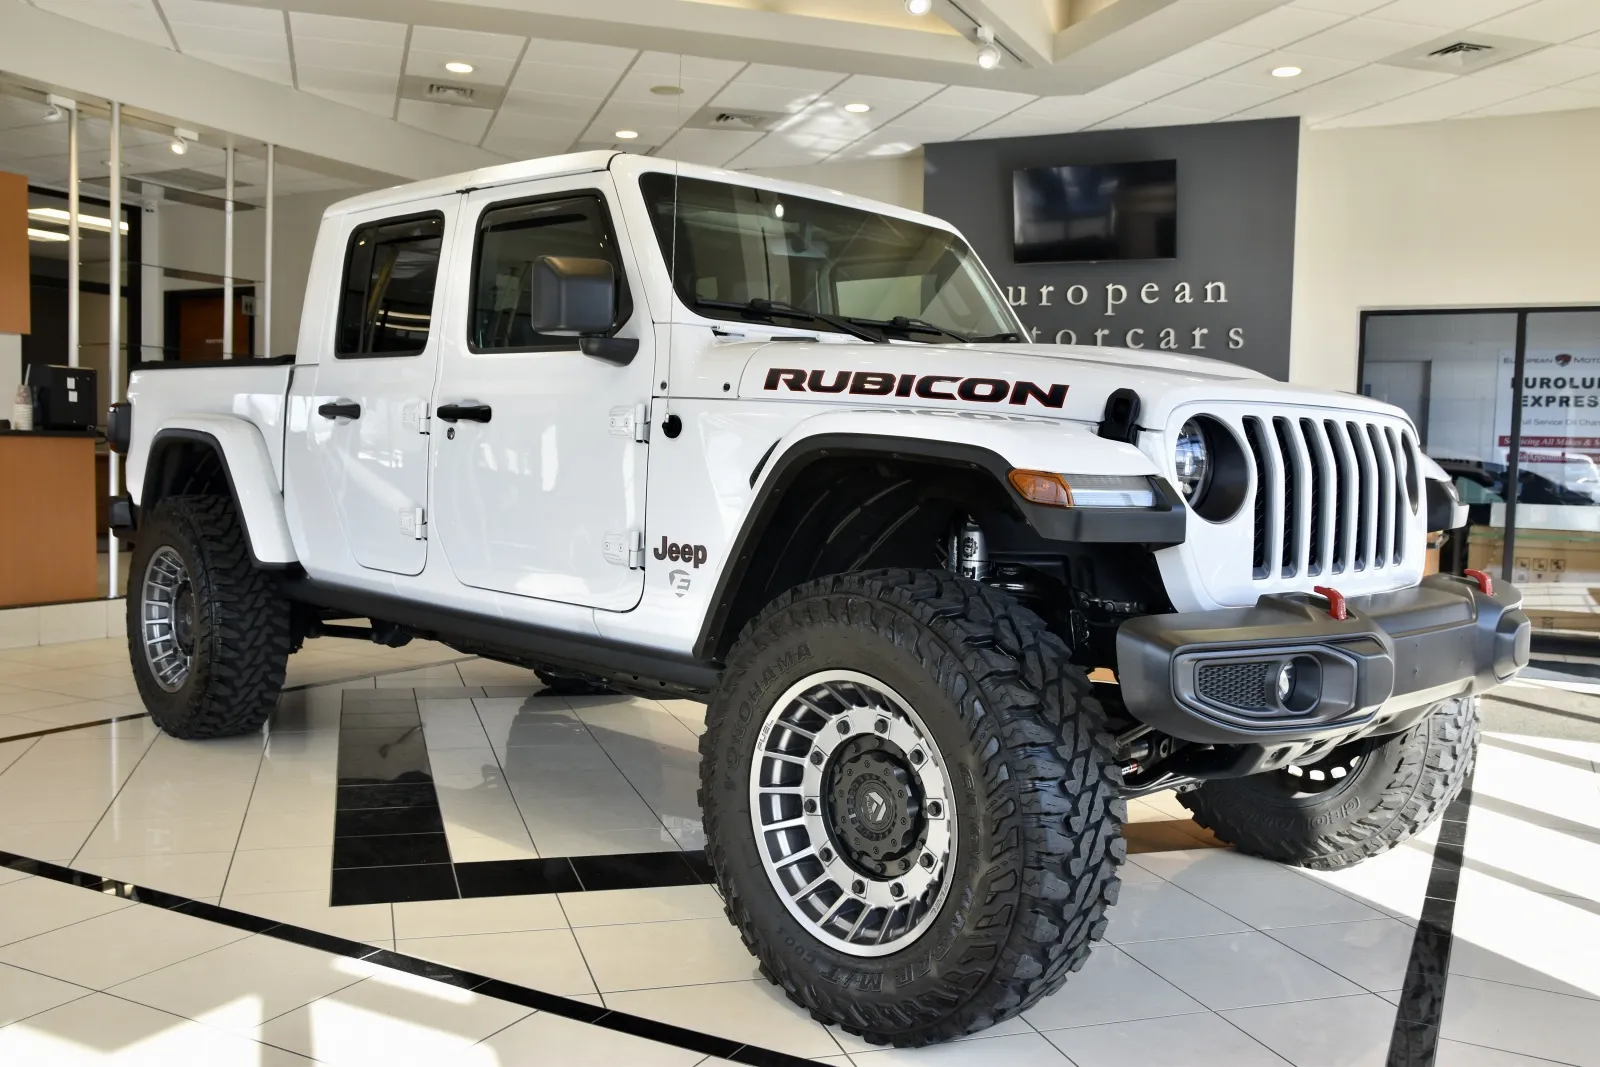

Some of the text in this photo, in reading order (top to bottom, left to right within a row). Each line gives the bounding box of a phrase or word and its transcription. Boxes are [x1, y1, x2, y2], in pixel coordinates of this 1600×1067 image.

[1006, 280, 1229, 316] uropean
[1031, 325, 1245, 349] torcars
[763, 367, 1070, 409] RUBICON
[1511, 377, 1600, 389] UROLU
[1541, 438, 1555, 446] All
[653, 535, 708, 569] Jeep
